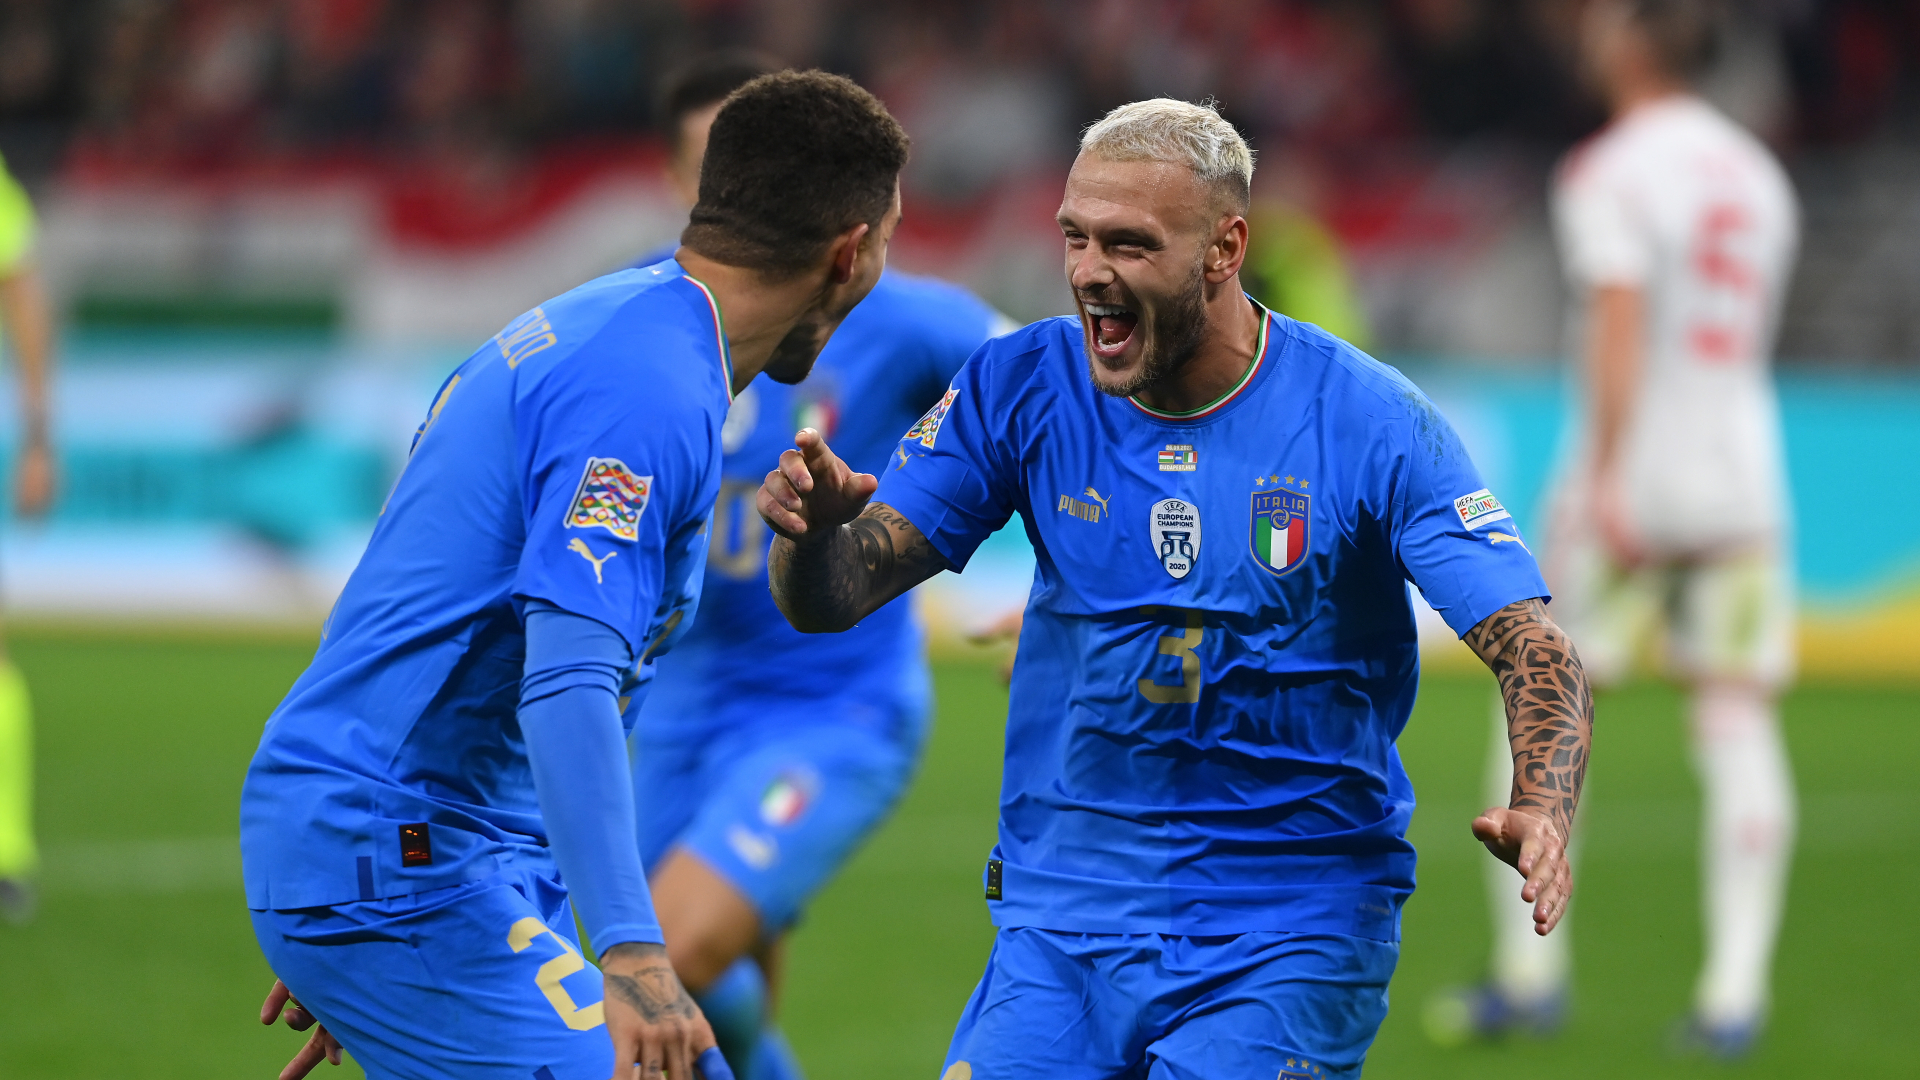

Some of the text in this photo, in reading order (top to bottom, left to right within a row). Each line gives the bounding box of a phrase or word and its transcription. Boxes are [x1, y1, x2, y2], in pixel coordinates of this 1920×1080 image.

[1058, 494, 1101, 523] PUMA
[1164, 502, 1186, 512] UEFA
[1256, 496, 1306, 512] ITALIA
[1456, 496, 1474, 509] UEFA
[1157, 513, 1194, 521] EUROPEAN
[1157, 520, 1194, 528] CHAMPIONS
[1169, 562, 1187, 571] 2020
[1137, 605, 1204, 704] 3
[506, 916, 606, 1031] 2
